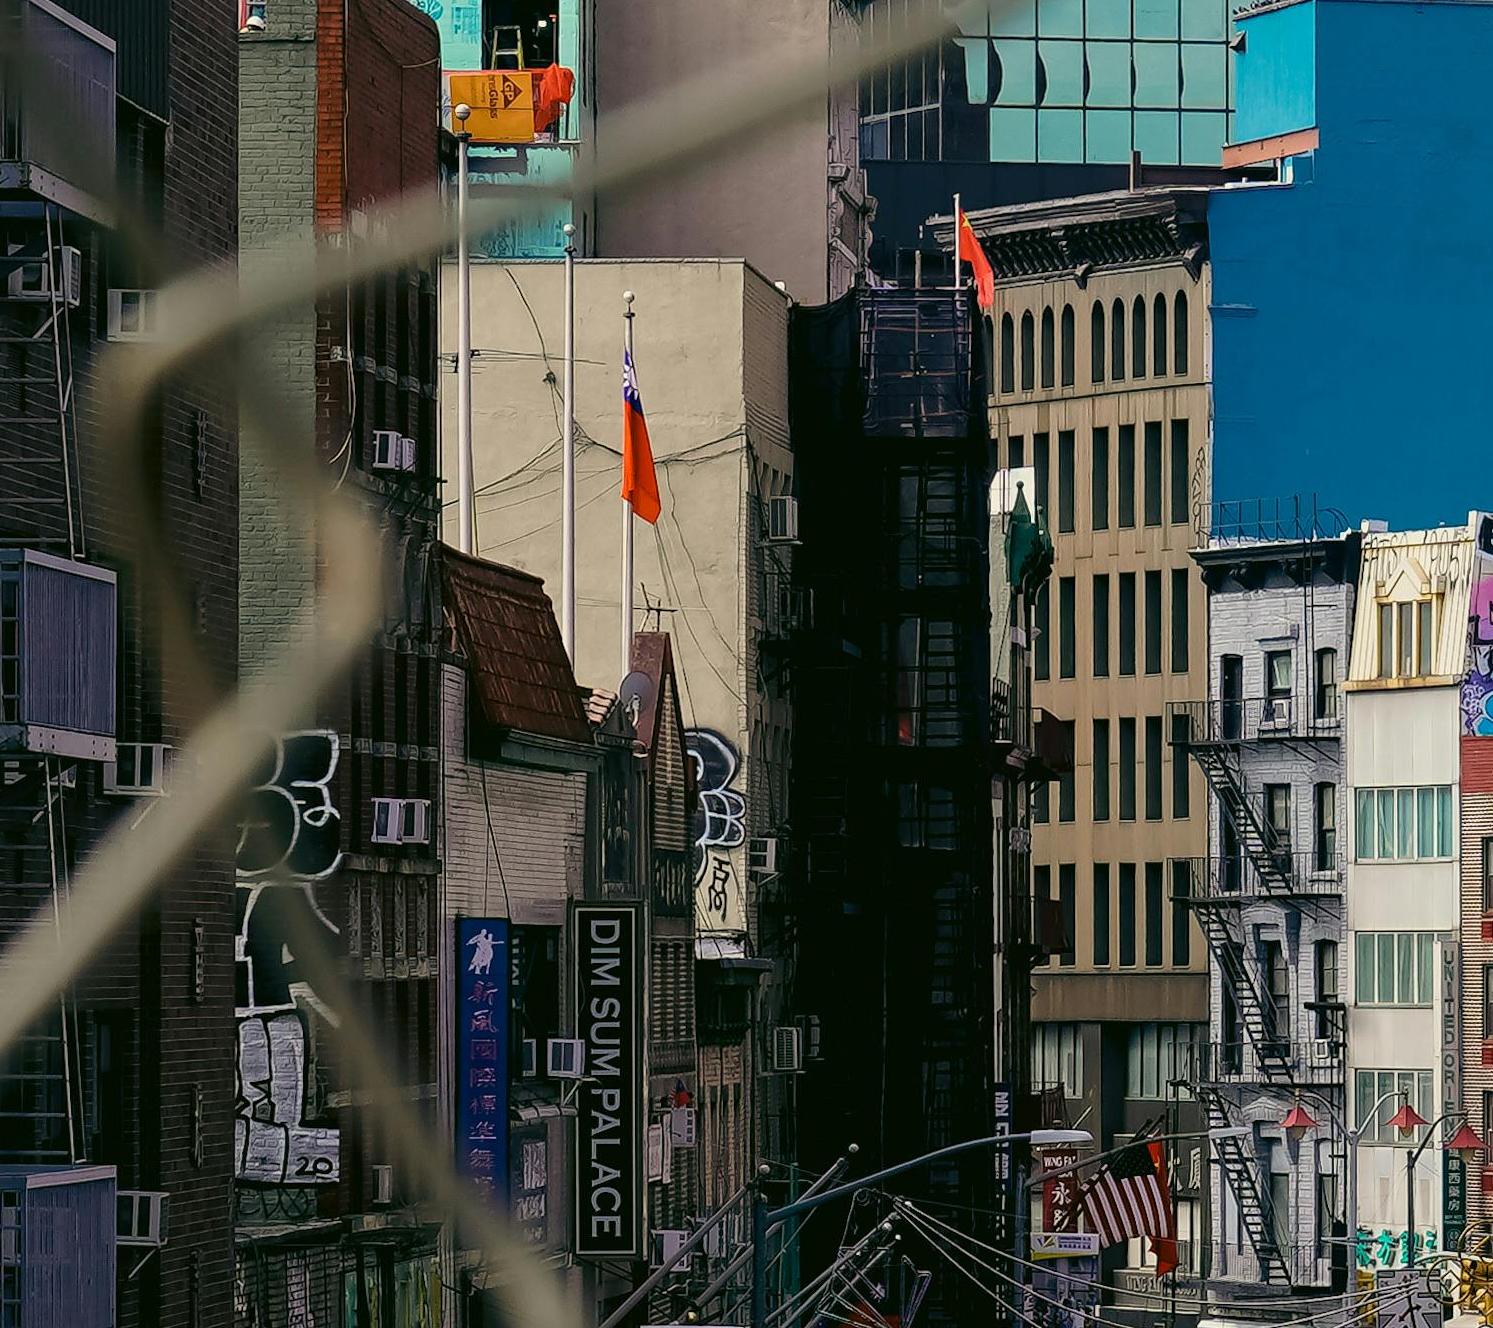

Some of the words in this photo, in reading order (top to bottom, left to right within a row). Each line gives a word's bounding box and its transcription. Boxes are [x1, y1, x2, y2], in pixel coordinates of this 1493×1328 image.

[590, 918, 622, 987] DIM
[590, 997, 622, 1077] SUM
[590, 1088, 622, 1238] PALACE
